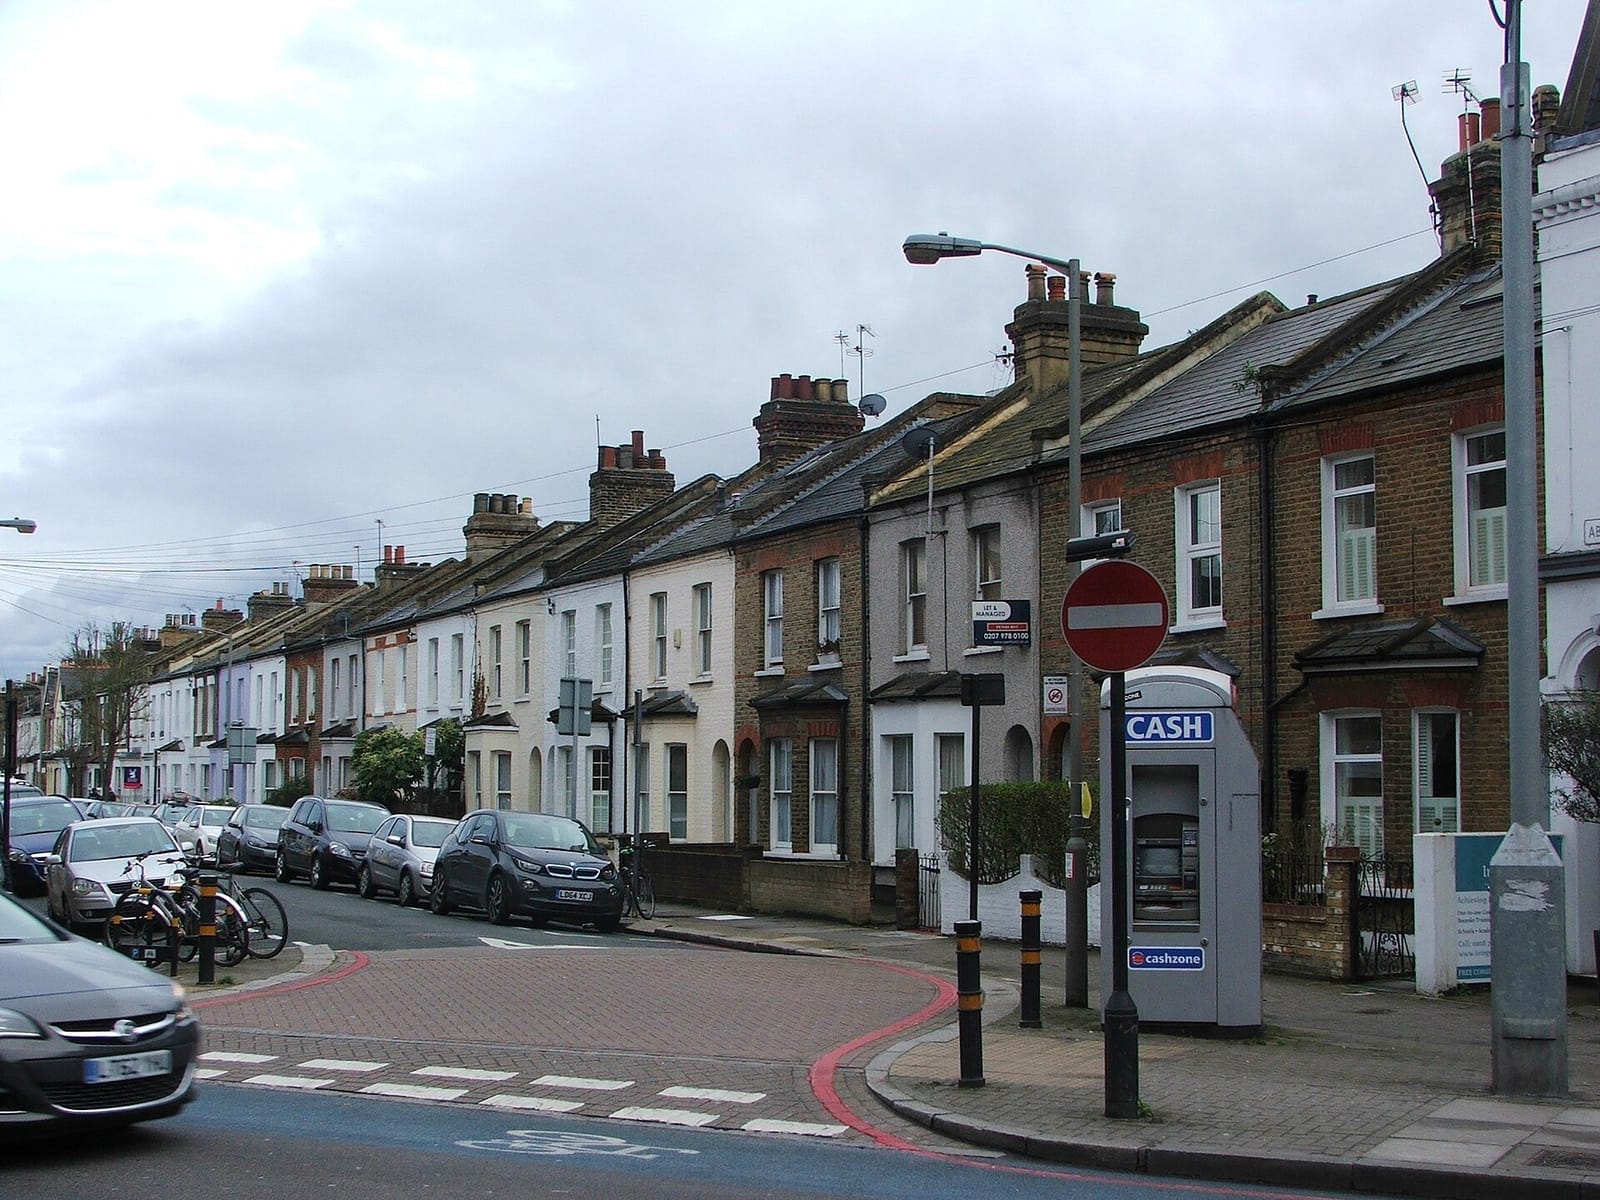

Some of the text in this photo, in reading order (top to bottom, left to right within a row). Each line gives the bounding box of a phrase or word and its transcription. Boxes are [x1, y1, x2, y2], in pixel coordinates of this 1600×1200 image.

[984, 632, 1000, 640] 0207
[1013, 632, 1029, 640] 0100
[1126, 716, 1202, 739] CASH
[1145, 952, 1201, 964] cashzone
